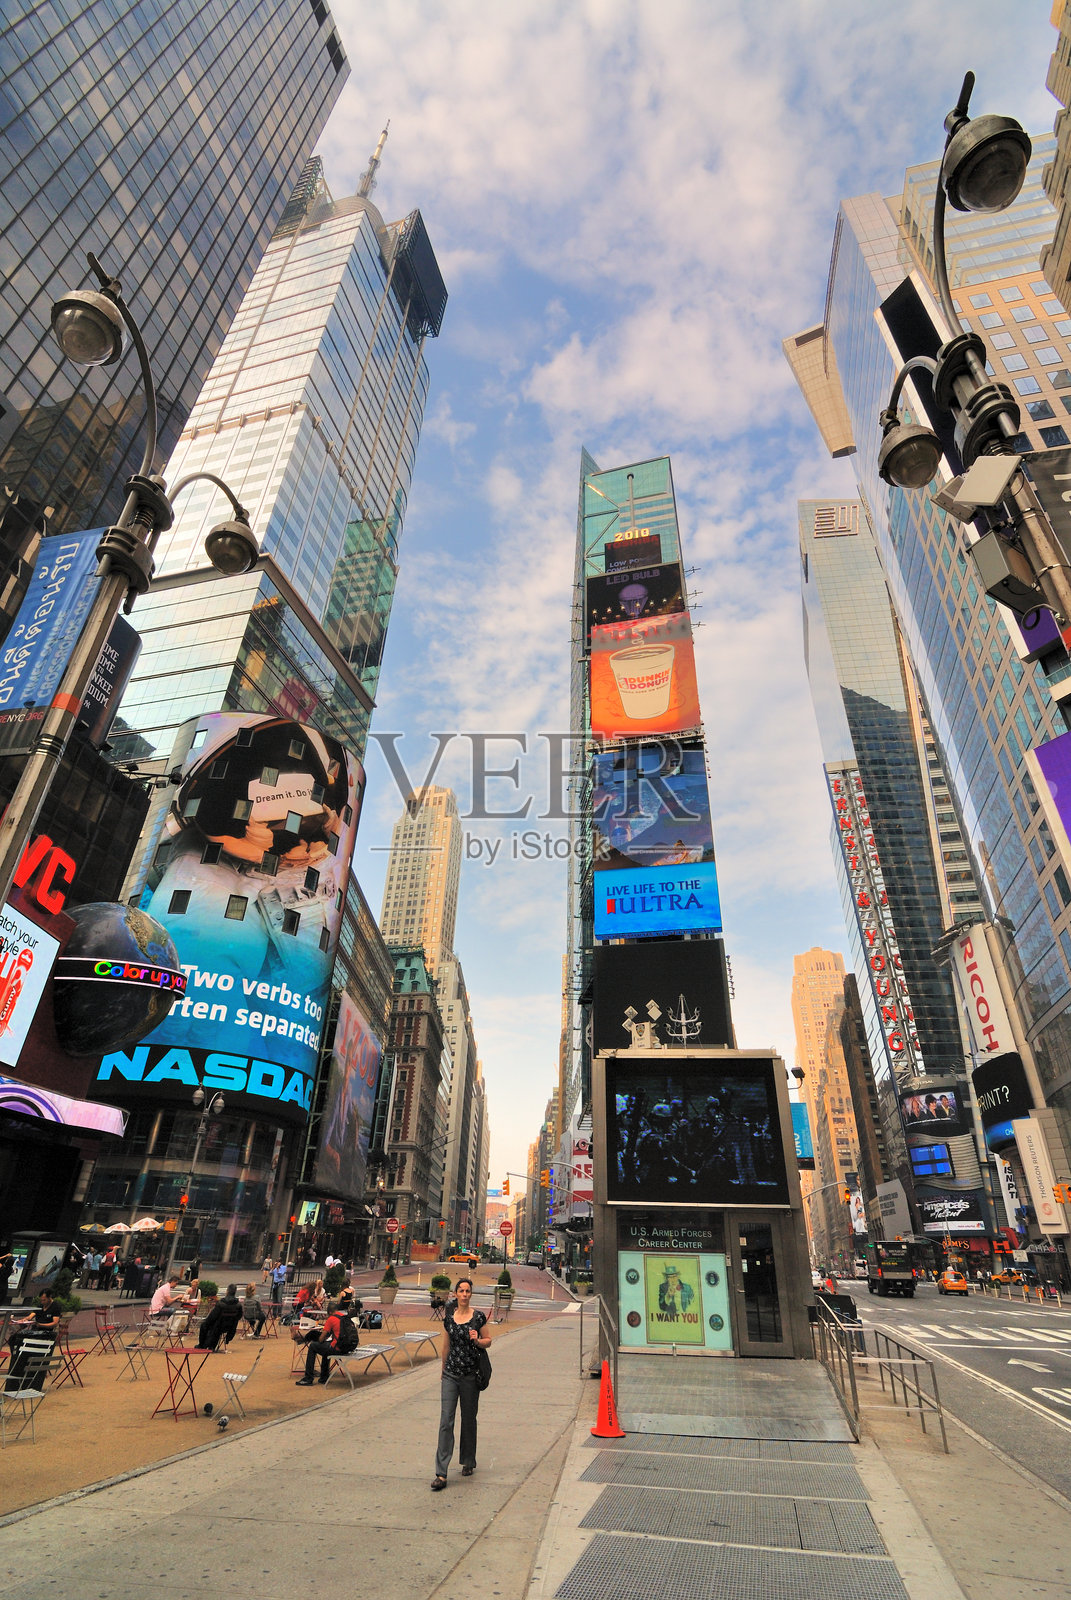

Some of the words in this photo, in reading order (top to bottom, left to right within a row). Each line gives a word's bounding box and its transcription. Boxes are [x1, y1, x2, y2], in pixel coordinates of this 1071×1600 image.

[614, 528, 650, 542] 2010
[606, 574, 630, 585] LED
[632, 569, 660, 581] BULB
[629, 675, 669, 690] DONUTS
[255, 792, 285, 804] Dream
[285, 790, 296, 799] it.
[296, 789, 307, 797] Do
[606, 885, 630, 896] LIVE
[634, 883, 656, 894] LIFE
[659, 881, 675, 892] TO
[678, 880, 702, 891] THE
[616, 892, 704, 914] ULTRA
[833, 778, 860, 871] ERNST
[865, 928, 904, 1051] YOUNG
[18, 927, 40, 949] your
[94, 960, 149, 980] Color
[150, 969, 170, 987] up
[181, 964, 234, 991] Two
[242, 977, 302, 1010] verbs
[303, 993, 323, 1022] too
[959, 936, 1000, 1053] RICOH
[339, 1008, 378, 1088] IZOD
[1025, 1134, 1039, 1165] REUTERS
[1033, 1164, 1048, 1199] THOMSON
[630, 1226, 650, 1236] U.S.
[650, 1312, 654, 1322] I
[656, 1313, 680, 1323] WANT
[682, 1313, 699, 1324] YOU
